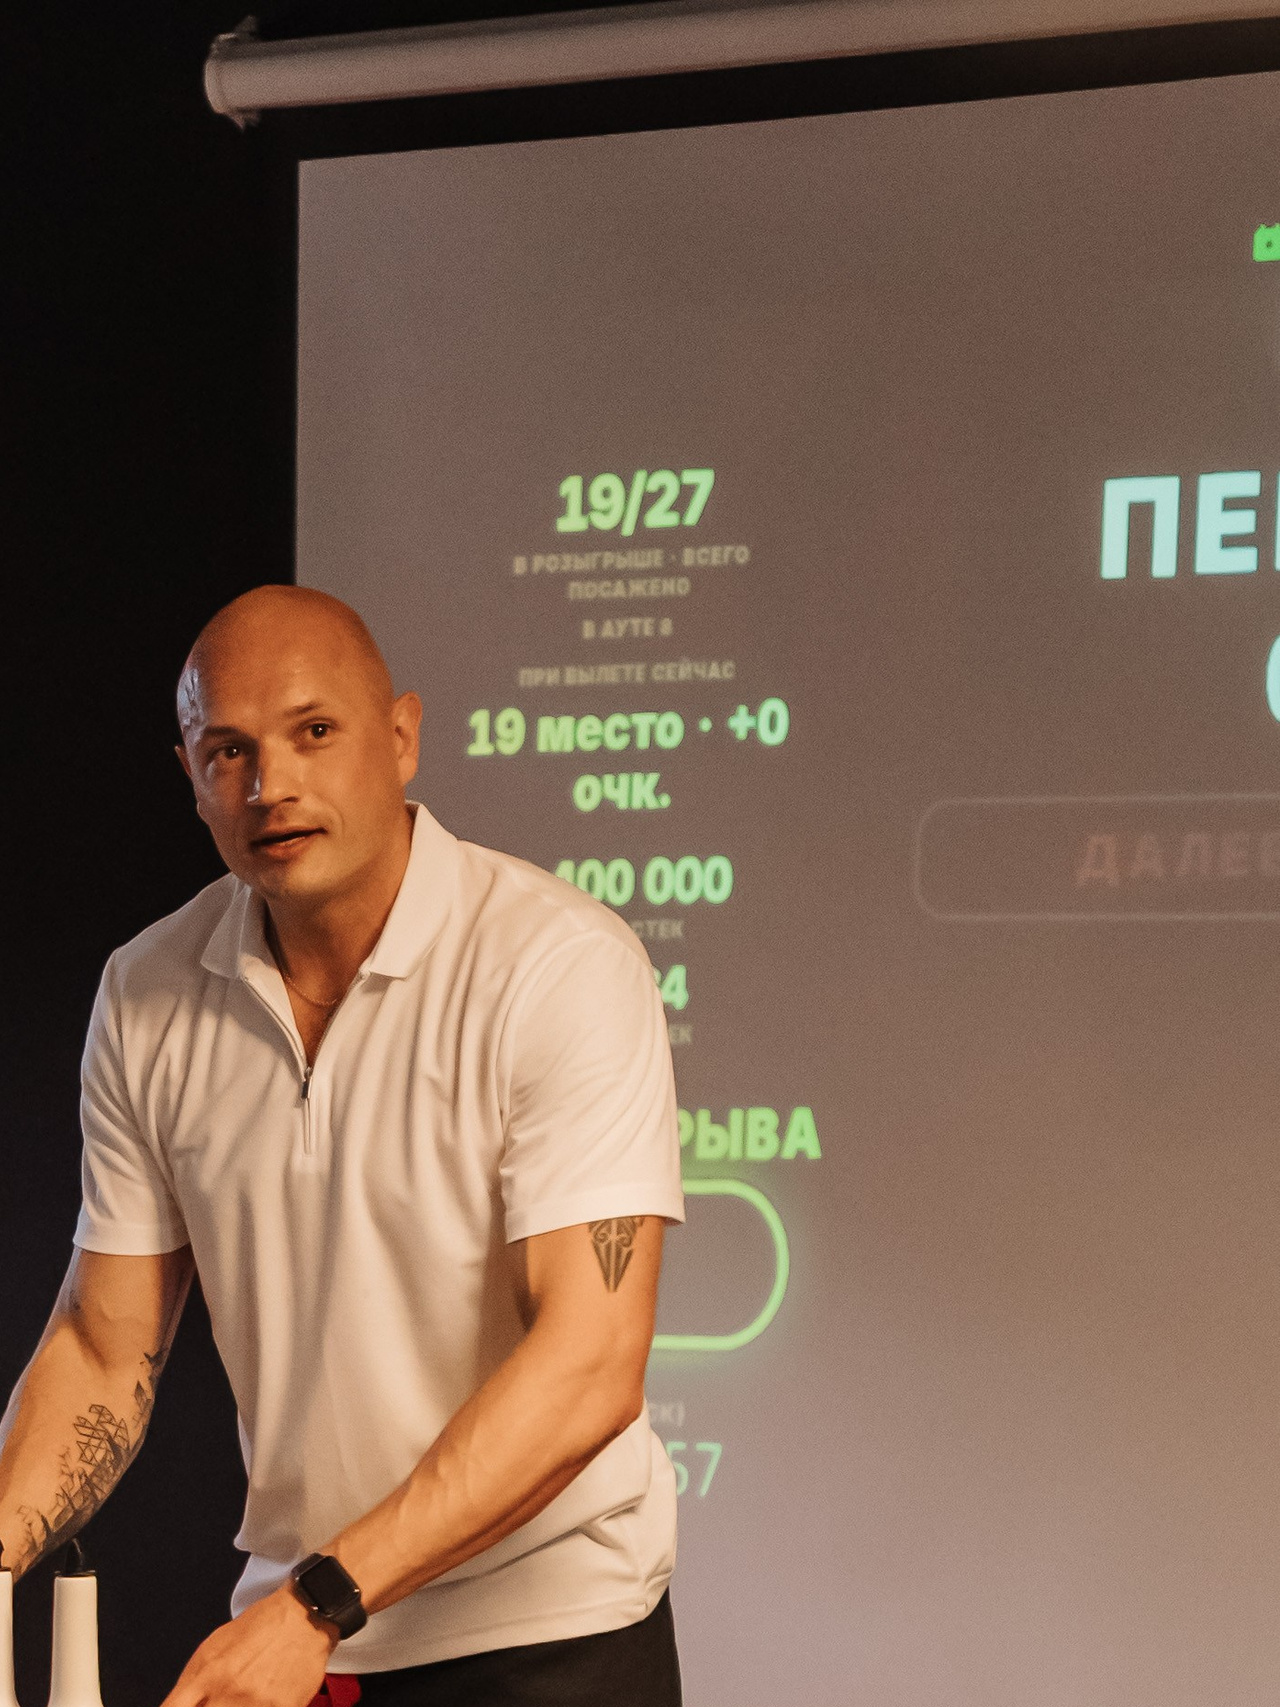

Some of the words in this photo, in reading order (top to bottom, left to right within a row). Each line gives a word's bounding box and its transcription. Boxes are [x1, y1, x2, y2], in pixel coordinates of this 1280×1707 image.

[556, 468, 716, 537] 19/27
[1100, 470, 1280, 580] ПЕ
[681, 545, 751, 567] ВСЕГО
[568, 576, 691, 600] ПОСАЖЕНО
[600, 617, 655, 638] АУТЕ
[650, 657, 737, 683] СЕЙЧАС
[467, 707, 527, 756] 19
[536, 711, 685, 753] место
[727, 697, 790, 747] +0
[643, 855, 734, 905] 000
